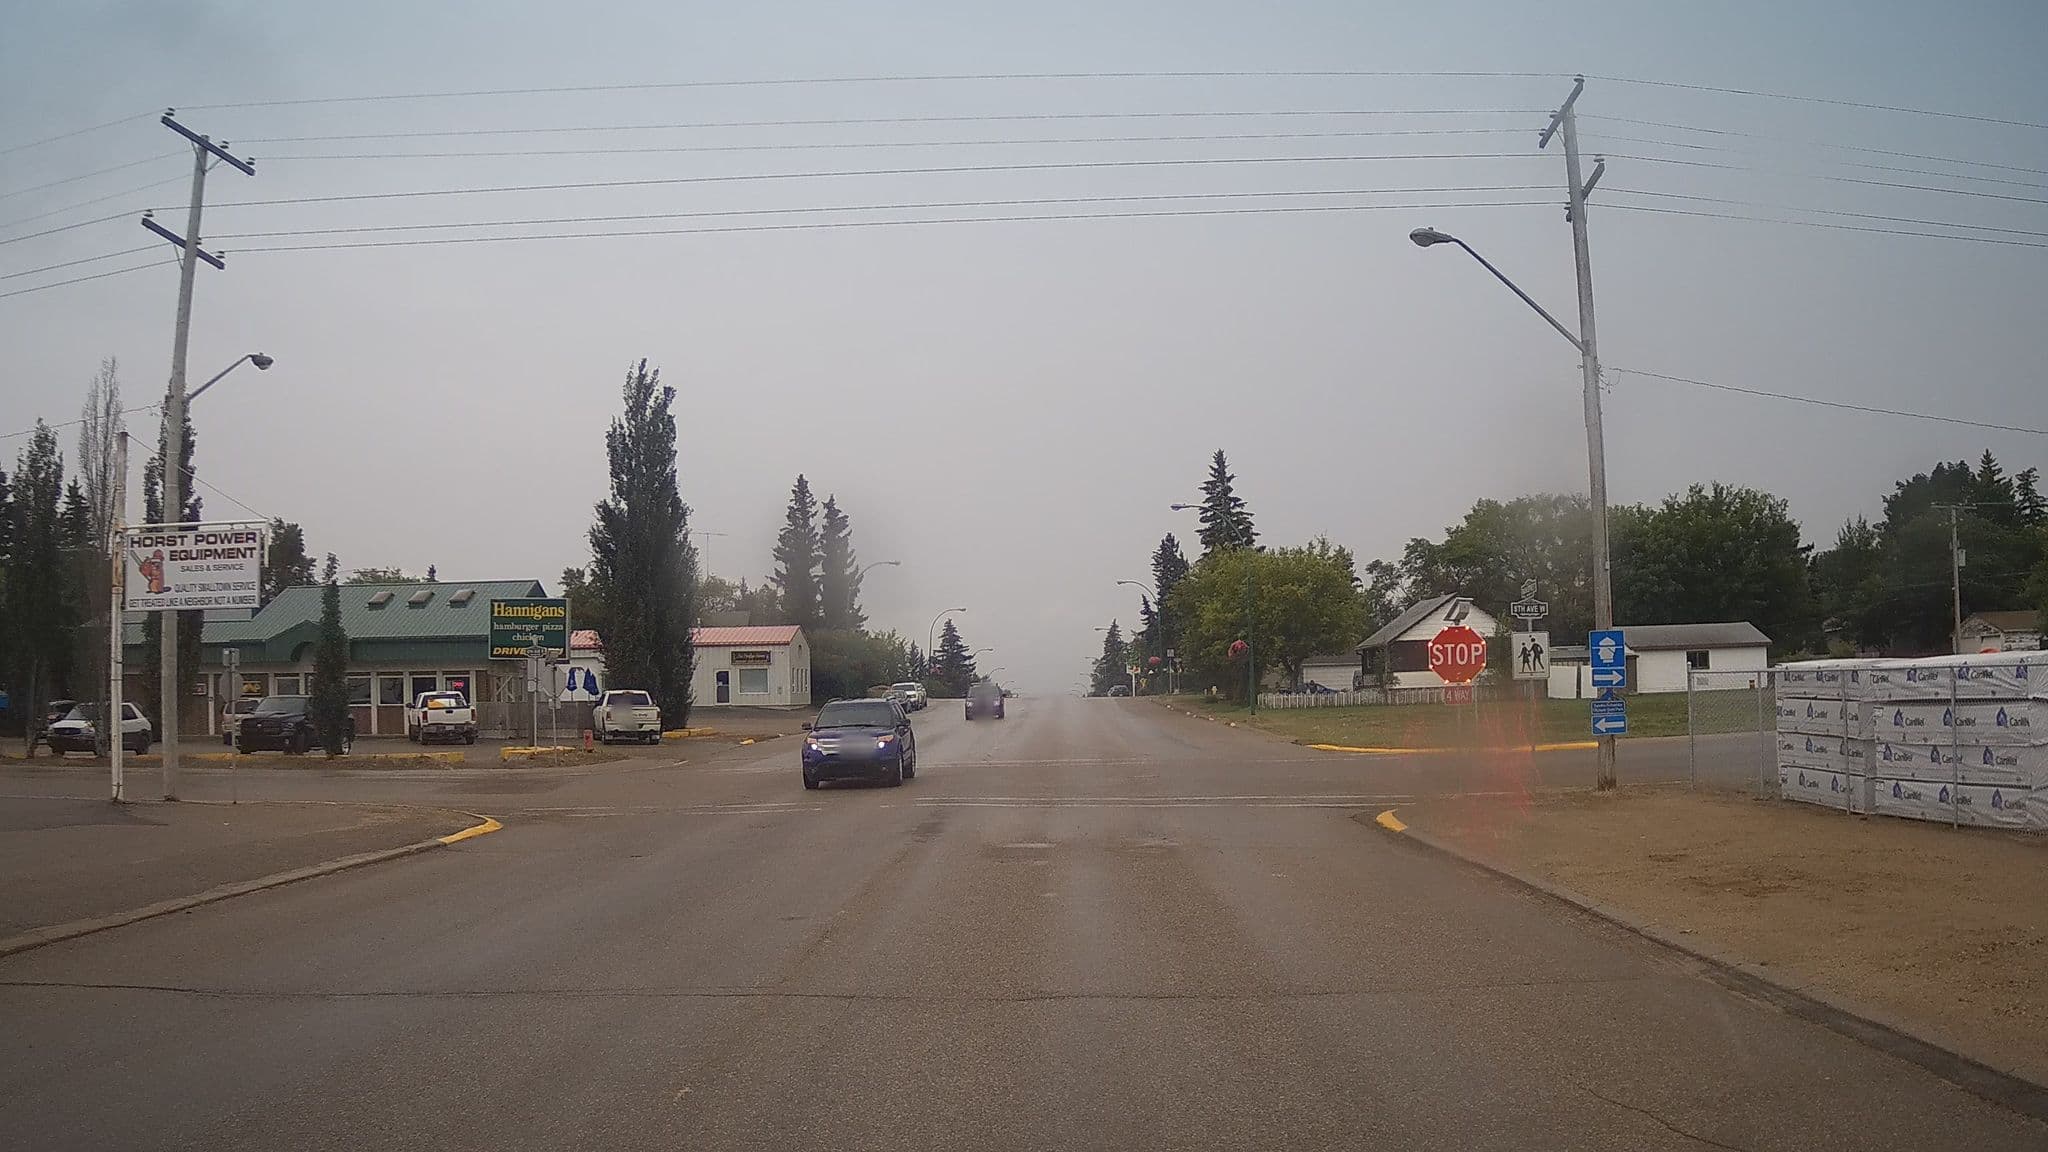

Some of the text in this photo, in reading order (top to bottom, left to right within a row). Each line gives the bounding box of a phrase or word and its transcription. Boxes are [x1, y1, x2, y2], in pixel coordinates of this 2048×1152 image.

[130, 531, 257, 548] HORST POWER
[169, 546, 257, 562] EQUIPMENT
[180, 564, 205, 573] SALES
[212, 563, 245, 571] SERVICE
[232, 581, 256, 591] SERVICE
[492, 601, 565, 620] Hannigans
[1526, 605, 1539, 613] AVE
[493, 621, 564, 632] hamburger pizza
[1431, 643, 1483, 666] STOP
[1446, 689, 1470, 702] 4 WAY
